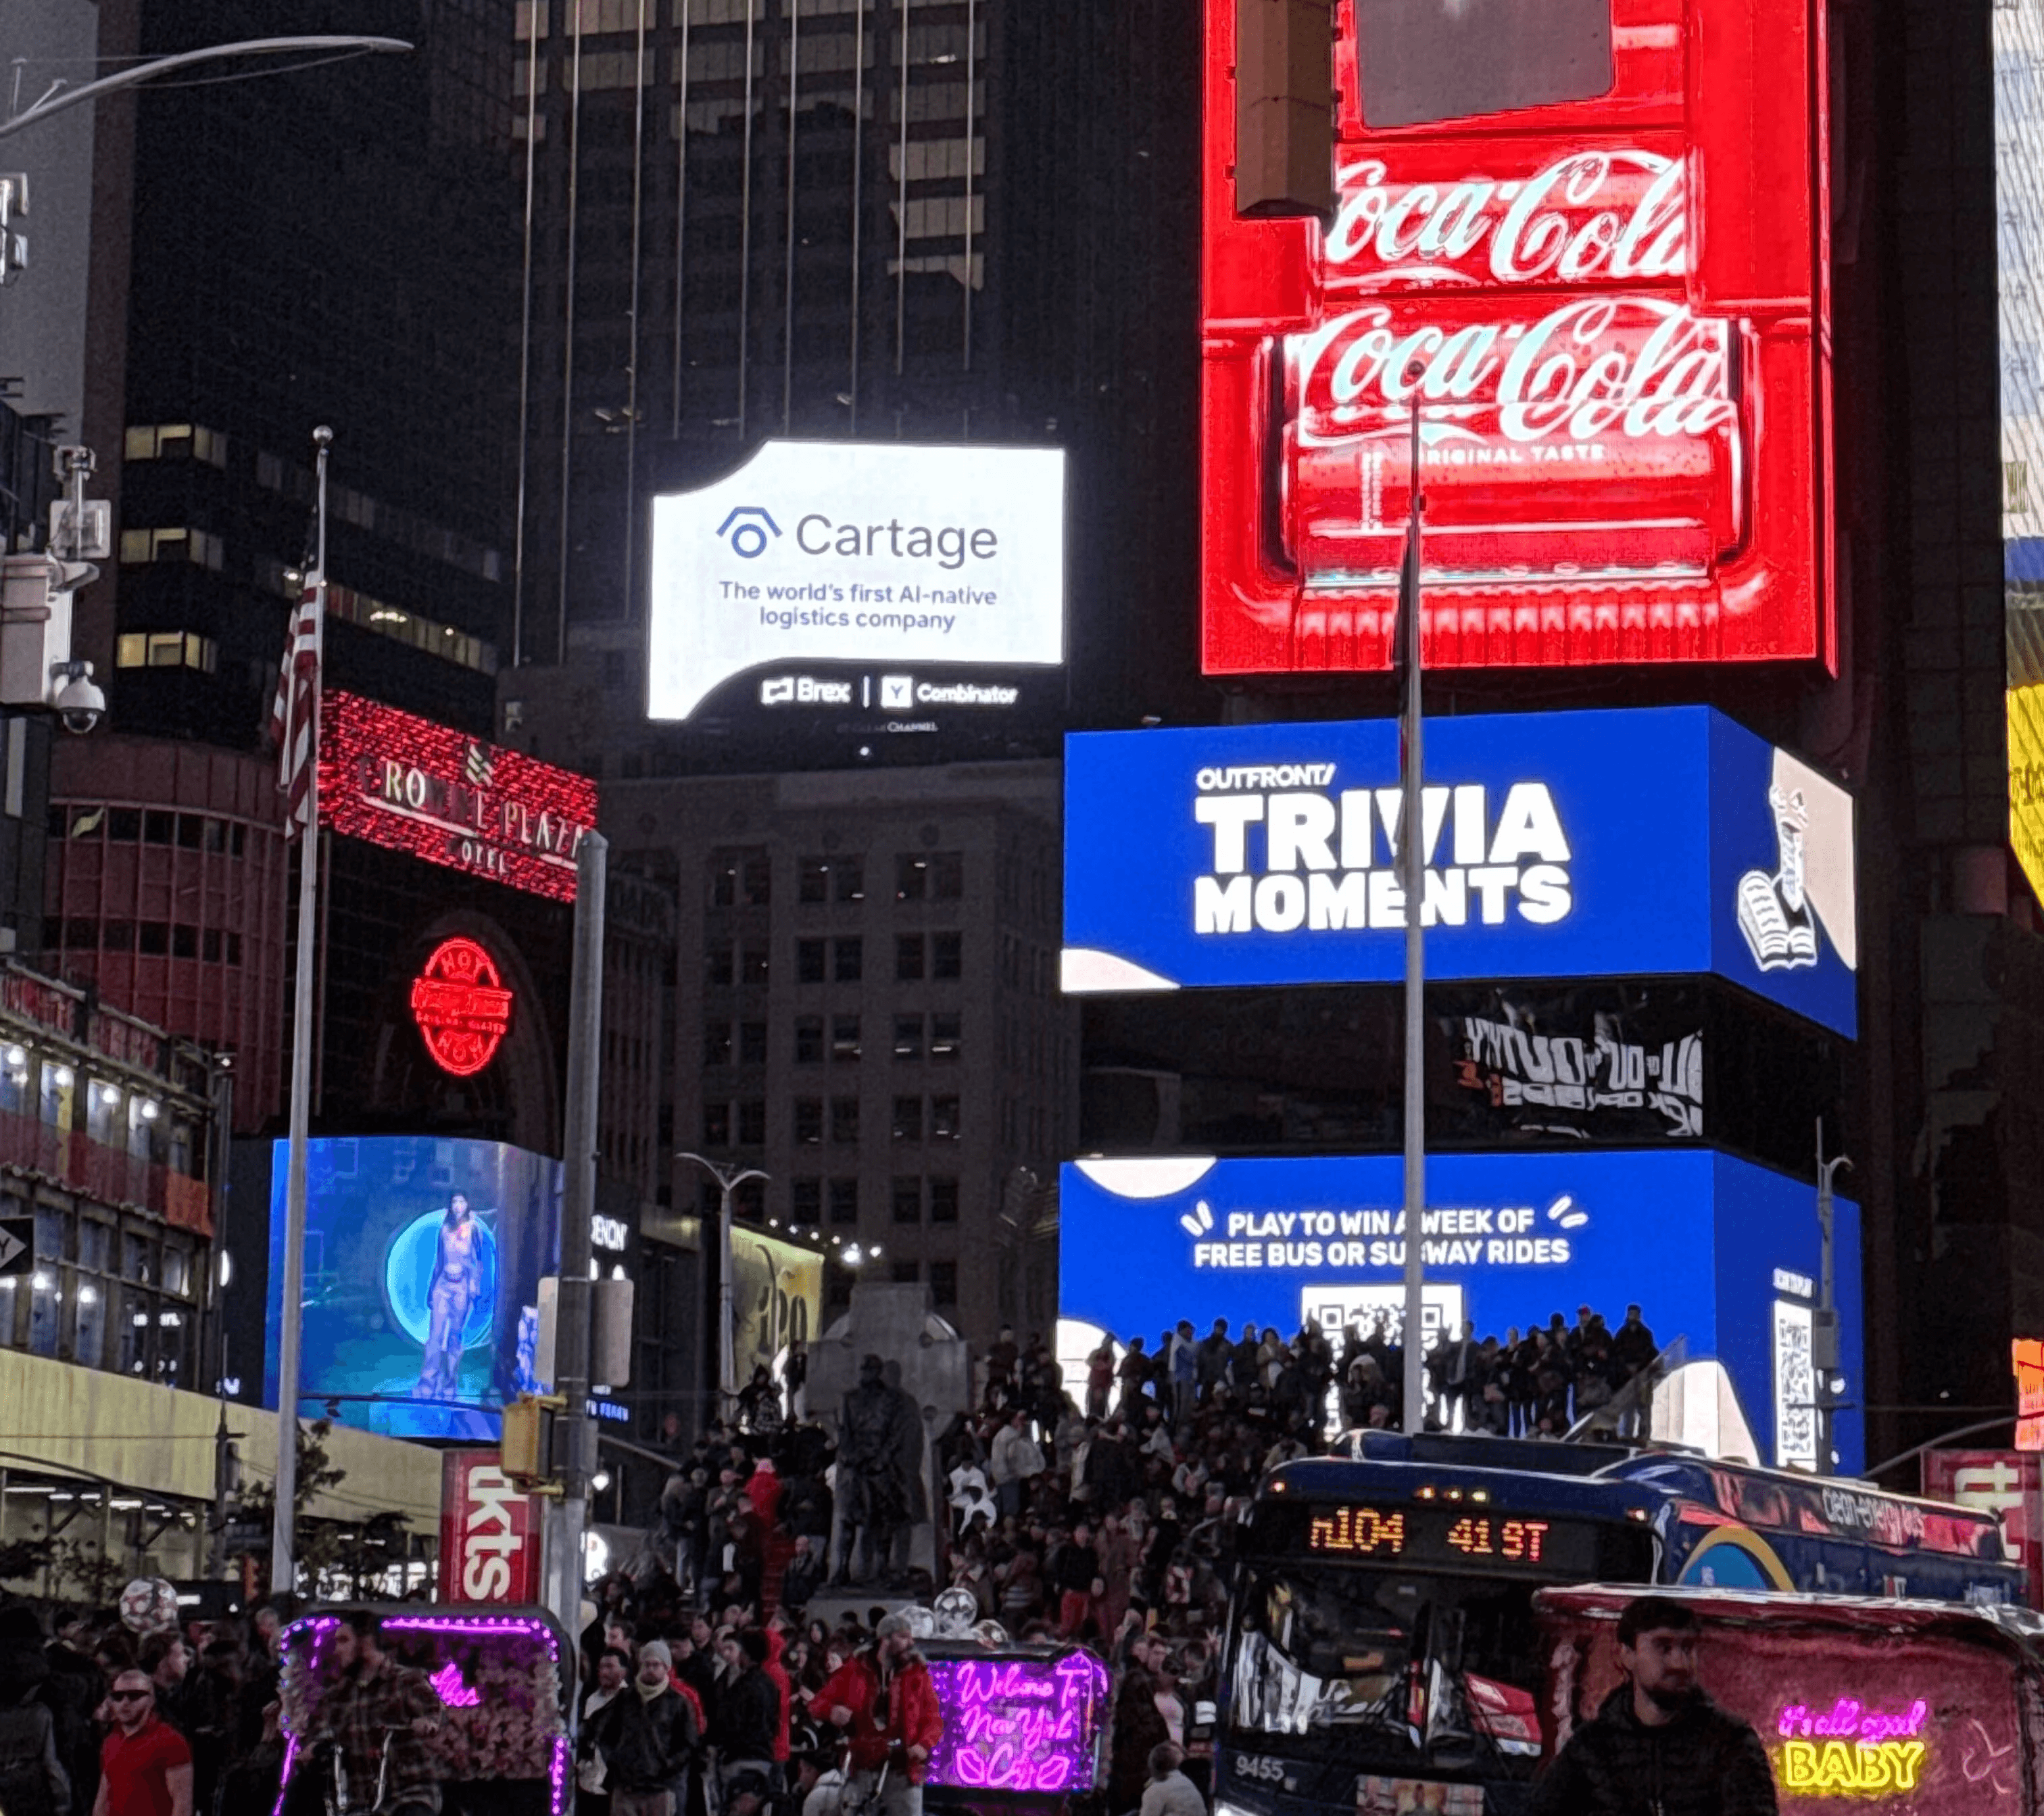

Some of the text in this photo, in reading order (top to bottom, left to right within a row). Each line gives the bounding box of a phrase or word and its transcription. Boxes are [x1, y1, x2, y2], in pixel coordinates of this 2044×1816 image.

[796, 513, 998, 570] Cartage
[719, 581, 998, 605] The world's first AI-native
[760, 606, 956, 634] logistics company
[797, 677, 852, 704] Brex
[917, 683, 1018, 704] Combinator
[1194, 782, 1572, 874] TRIVIA
[461, 840, 507, 876] OTEL
[1194, 865, 1572, 934] MOMENTS
[1227, 1211, 1296, 1238] PLAY
[1299, 1211, 1336, 1237] TO
[1340, 1210, 1390, 1236] WIN
[1420, 1208, 1494, 1235] WEEK
[1497, 1208, 1535, 1233] OF
[1194, 1238, 1571, 1268] FREE BUS OR SUWAY RIDES
[463, 1465, 530, 1601] tkts
[1447, 1519, 1493, 1554] 41
[1501, 1521, 1549, 1562] ST
[1235, 1754, 1284, 1782] 9455
[1784, 1740, 1925, 1789] BABY
